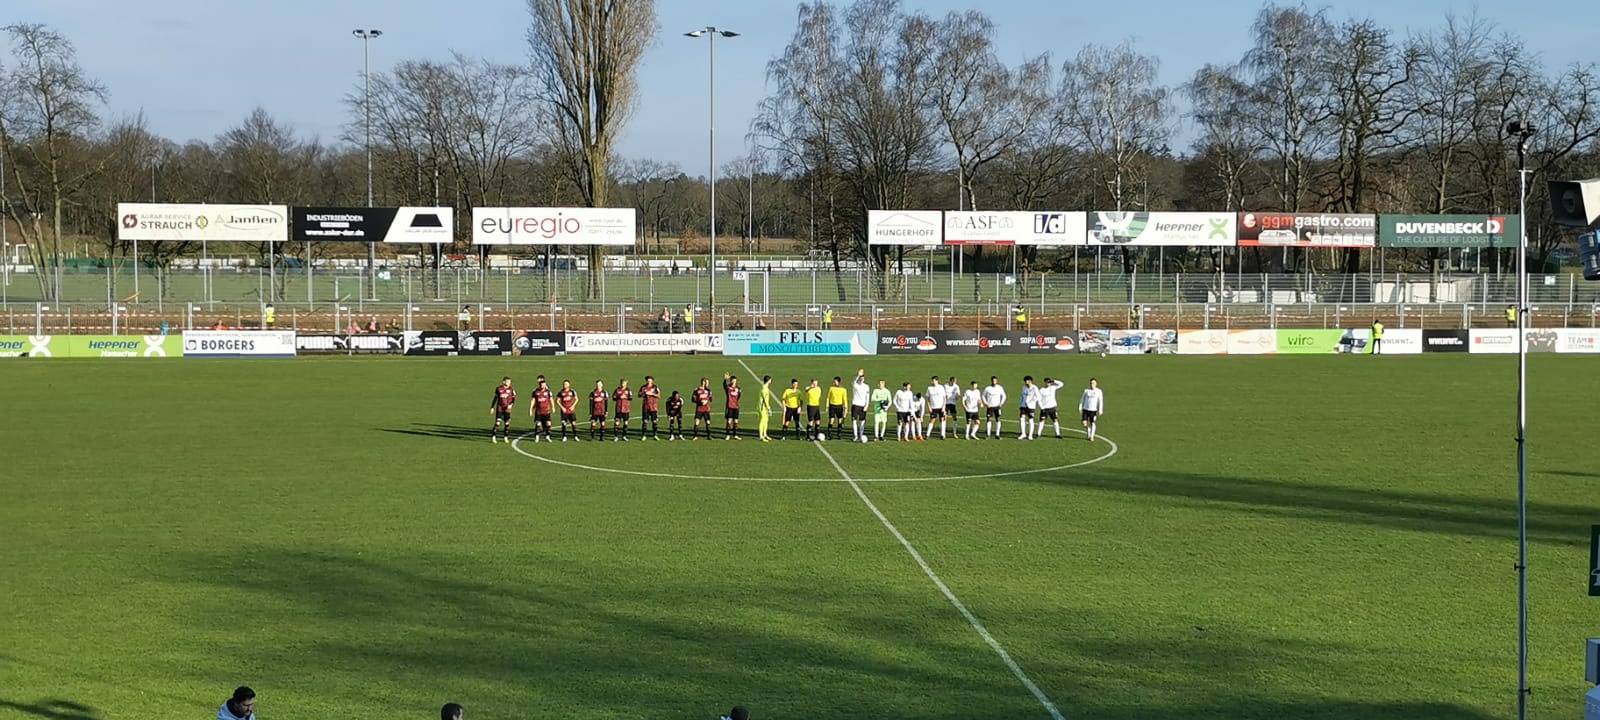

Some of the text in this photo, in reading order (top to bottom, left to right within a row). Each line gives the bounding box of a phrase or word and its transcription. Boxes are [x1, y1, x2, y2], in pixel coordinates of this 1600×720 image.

[140, 221, 193, 230] STRAUCH
[480, 212, 581, 239] euregio
[965, 215, 998, 230] ASF
[1262, 214, 1375, 229] ggmgastro.com
[875, 229, 935, 237] HUNGERHOFF
[1395, 222, 1485, 234] DUVENBECK
[1396, 235, 1411, 243] THE
[1413, 235, 1449, 244] CULTURE
[1449, 235, 1459, 243] OF
[587, 337, 702, 346] SANIERUNGSTECHNIK
[779, 331, 824, 344] FELS
[1286, 334, 1314, 346] wiro
[200, 339, 256, 351] BORGERS
[759, 343, 846, 354] MONOLITHBETON
